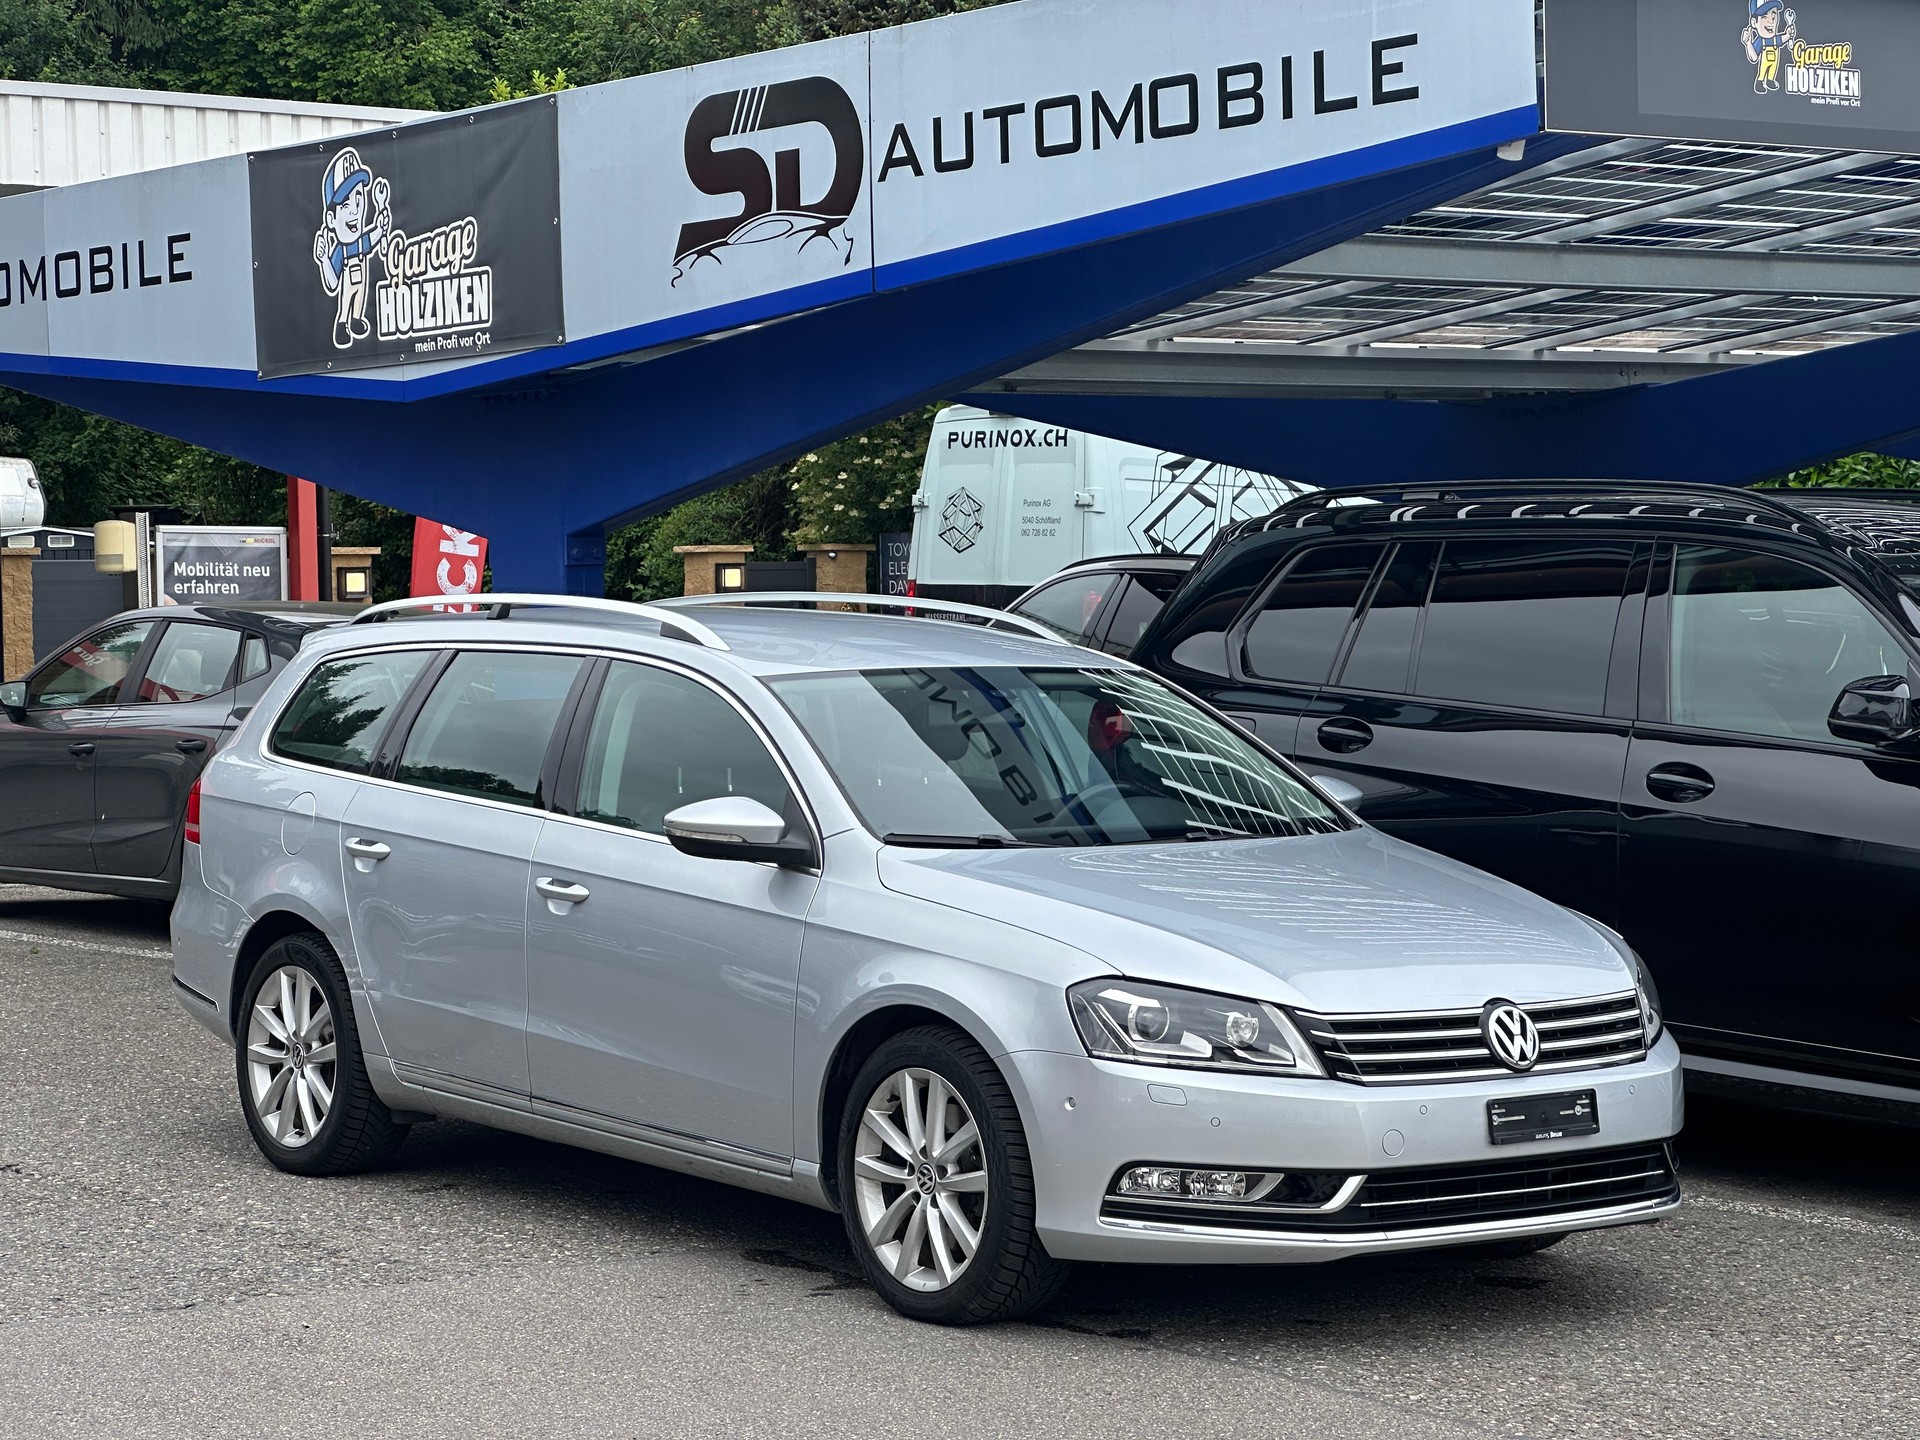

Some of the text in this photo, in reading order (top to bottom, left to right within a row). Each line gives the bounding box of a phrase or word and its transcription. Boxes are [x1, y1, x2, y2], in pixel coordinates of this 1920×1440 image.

[1793, 41, 1850, 70] Garage
[1787, 66, 1859, 97] HOLZIKEN
[1826, 97, 1840, 106] Profi
[1850, 98, 1860, 107] Ort
[673, 32, 1420, 266] SD AUTOMOBILE
[387, 223, 474, 290] Garage
[380, 274, 489, 333] HOLZIKEN
[415, 331, 491, 353] mein Profi vor Ort
[947, 428, 1068, 450] PURINOX.CH
[1042, 499, 1051, 507] AG
[1022, 516, 1034, 524] 5040
[888, 542, 911, 556] TOY
[173, 562, 270, 577] Mobilität neu
[888, 561, 909, 575] ELE
[174, 579, 240, 595] erfahren
